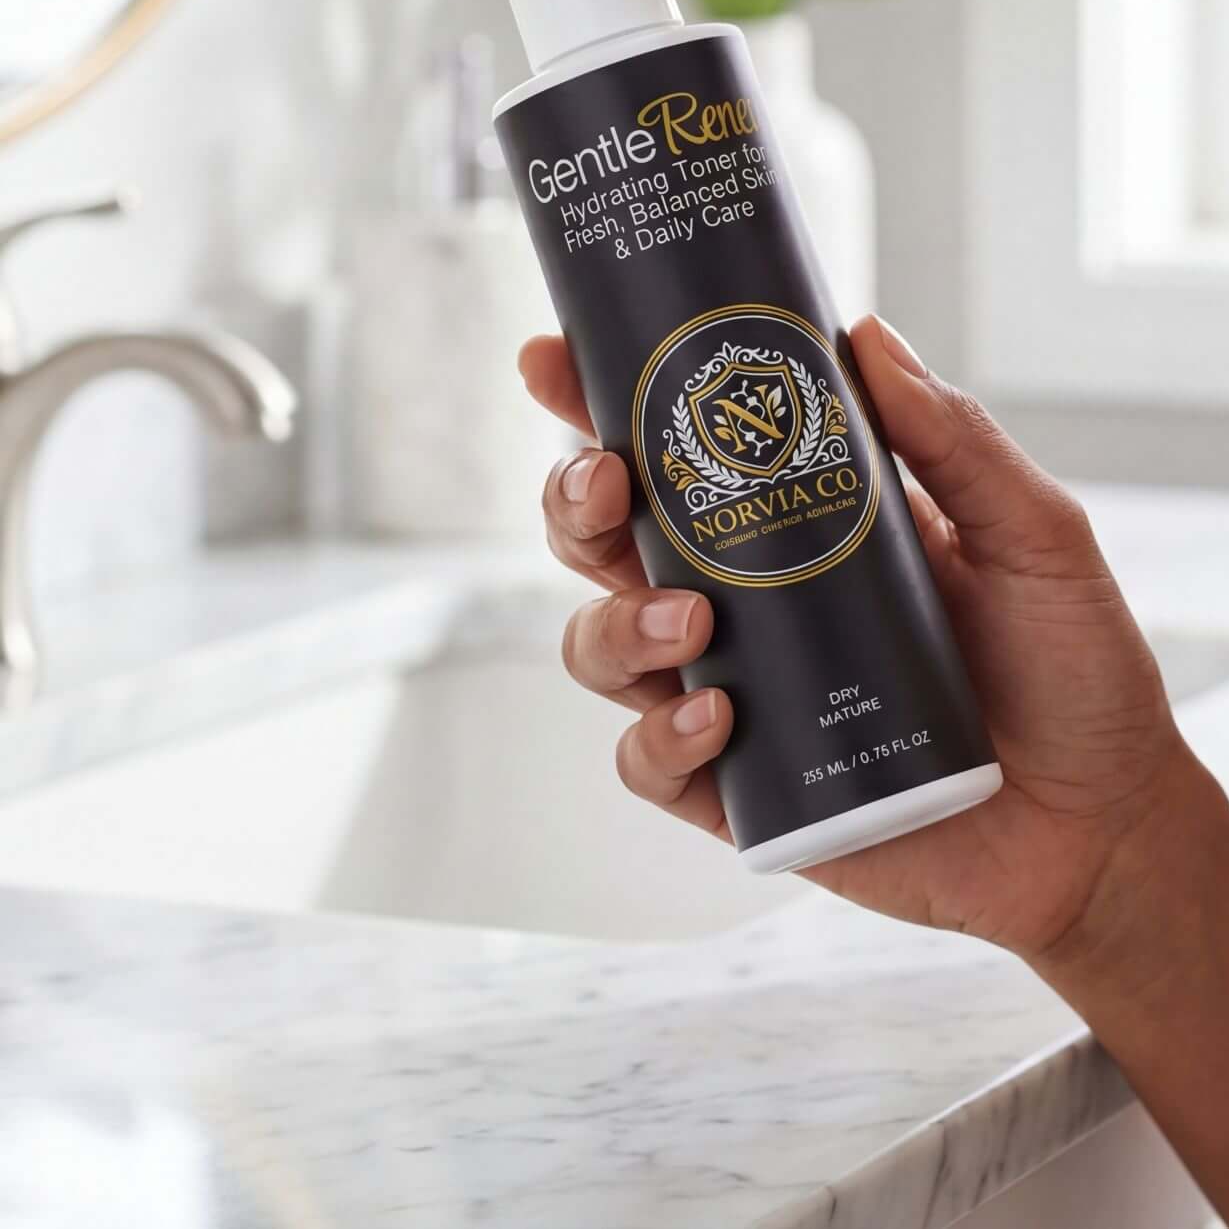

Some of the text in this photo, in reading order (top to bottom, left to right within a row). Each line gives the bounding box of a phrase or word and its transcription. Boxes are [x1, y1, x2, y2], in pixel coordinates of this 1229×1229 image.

[528, 125, 657, 204] Gentle
[560, 143, 766, 226] Hydrating Toner for
[563, 165, 777, 253] Fresh, Balanced Skin
[615, 200, 755, 260] & Daily Care
[691, 482, 814, 543] NORVIA
[816, 466, 864, 499] CO.
[819, 697, 882, 728] MATURE
[829, 684, 860, 705] DRY
[802, 730, 932, 785] 255 ML / 0.75 FL OZ
